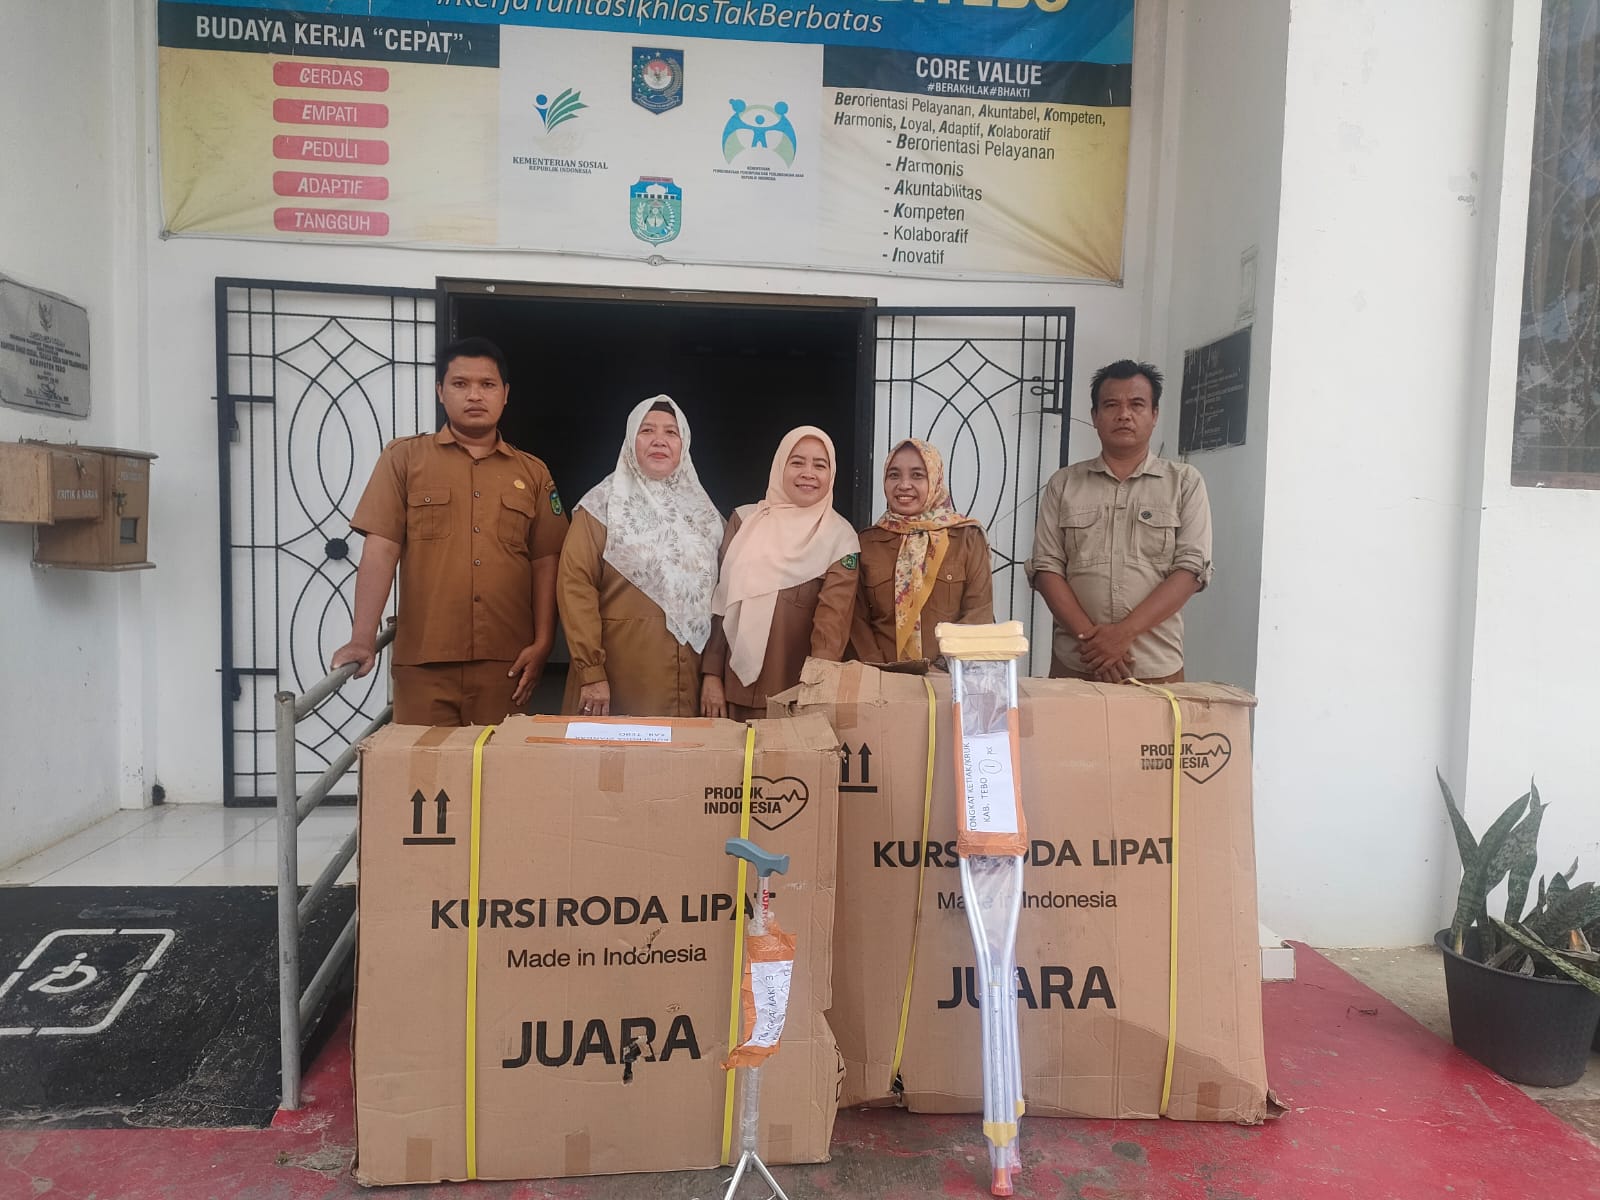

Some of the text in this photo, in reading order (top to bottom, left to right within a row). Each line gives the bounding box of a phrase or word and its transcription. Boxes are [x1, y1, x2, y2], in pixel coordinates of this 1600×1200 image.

[196, 16, 286, 43] BUDAYA
[294, 24, 365, 48] KERJA
[916, 56, 1042, 85] CORE VALUE
[927, 83, 1030, 98] #BERAKHLAK#BHAKTI
[302, 104, 357, 122] EMPATI
[834, 92, 1106, 127] Berorientasi Pelayanan, Akuntabel, Kompeten,
[834, 112, 1052, 141] Harmonis, Loyal, Adaptif, Kolaboratif
[302, 140, 358, 159] PEDULI
[896, 134, 980, 155] Berorientasi
[985, 141, 1055, 160] Pelayanan
[512, 156, 609, 170] KEMENTERIAN SOSIAL
[895, 156, 964, 177] Harmonis
[298, 177, 363, 194] ADAPTIF
[894, 179, 983, 201] Akuntabilitas
[295, 212, 370, 231] TANGGUH
[893, 203, 965, 222] Kompeten
[893, 225, 969, 244] Kolaboratif
[892, 247, 945, 265] Inovatif
[979, 777, 989, 799] TEBO
[704, 801, 782, 814] INDOESIA
[873, 841, 960, 868] KURS
[1023, 891, 1117, 908] Indonesia
[431, 899, 546, 929] KURSI
[556, 896, 669, 927] RODA
[507, 944, 707, 968] Made in Indonesia
[502, 1014, 701, 1069] JUARA
